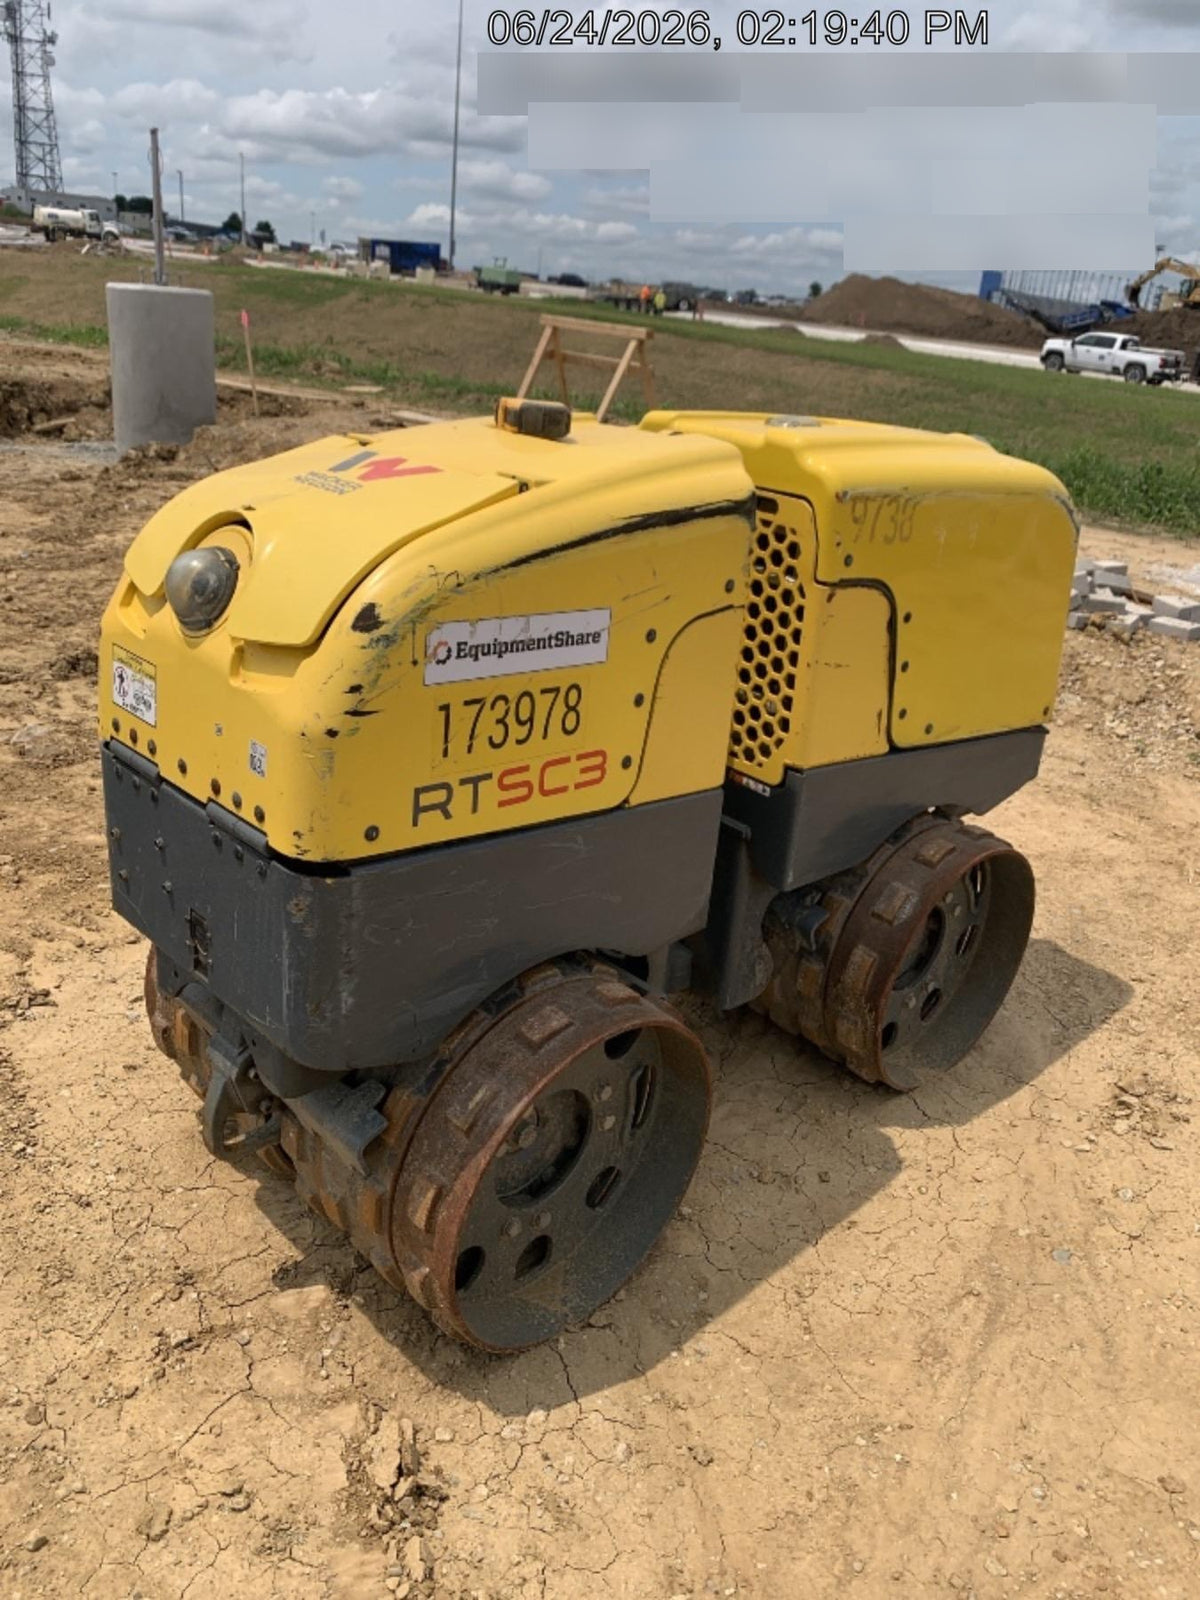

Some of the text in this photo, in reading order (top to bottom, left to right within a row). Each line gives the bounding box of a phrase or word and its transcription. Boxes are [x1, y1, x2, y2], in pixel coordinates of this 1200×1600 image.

[455, 630, 601, 661] EquipmentShare
[438, 683, 582, 758] 173978
[412, 749, 607, 827] RTSC3
